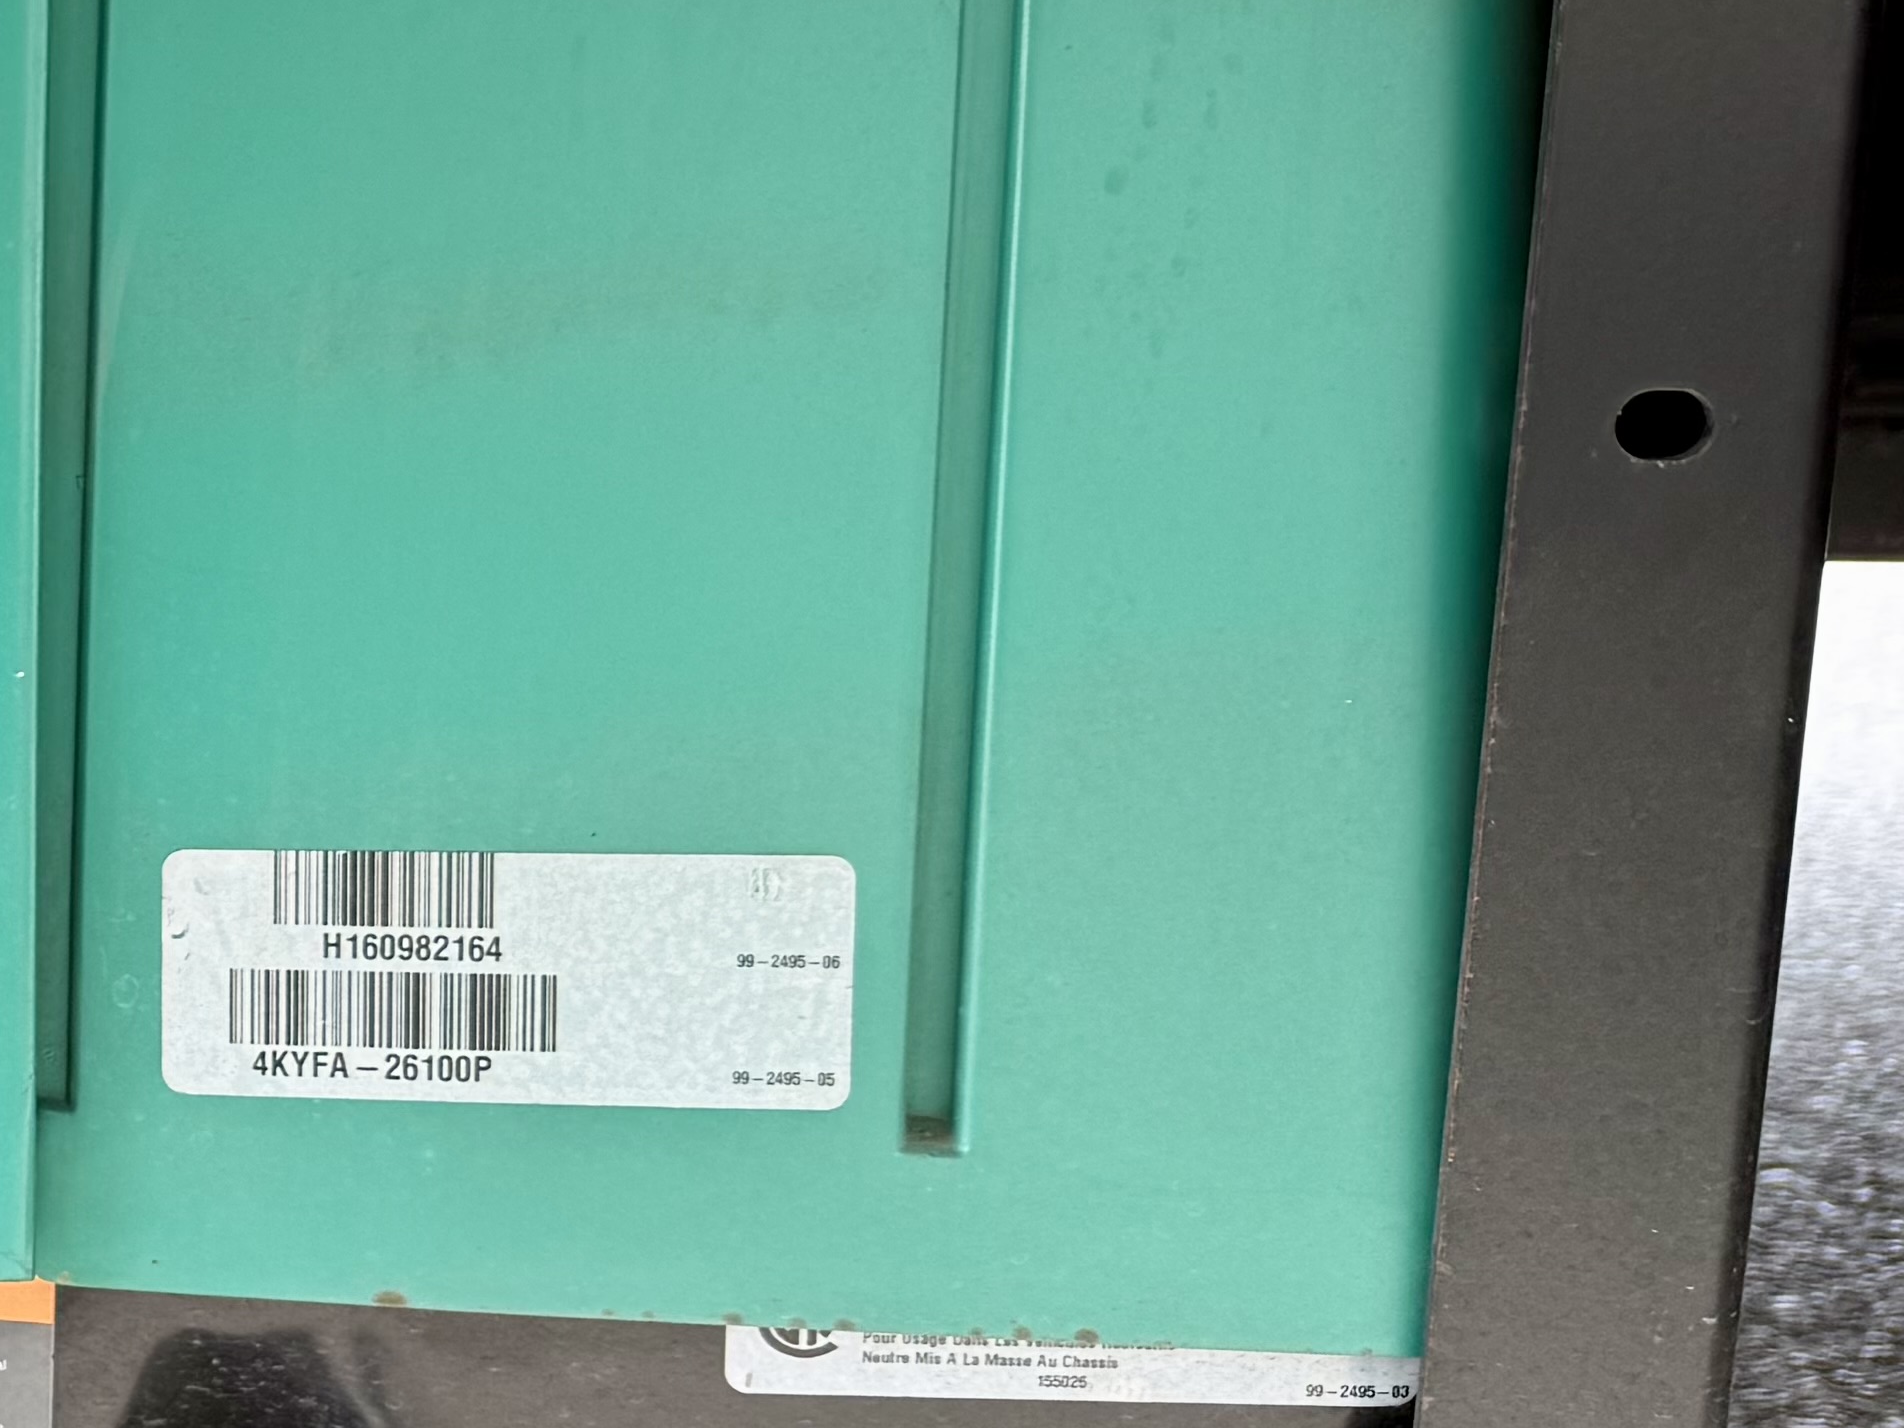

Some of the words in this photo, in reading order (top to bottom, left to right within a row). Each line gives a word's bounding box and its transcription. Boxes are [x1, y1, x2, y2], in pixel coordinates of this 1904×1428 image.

[321, 933, 503, 963] H160982164
[862, 1351, 910, 1364] Neutre
[916, 1352, 941, 1365] Mis
[946, 1353, 956, 1365] A
[963, 1353, 979, 1366] La
[985, 1354, 1032, 1367] Masse
[1037, 1355, 1057, 1367] Au
[1063, 1356, 1119, 1369] Chassis
[1305, 1383, 1411, 1401] 99-2495-03
